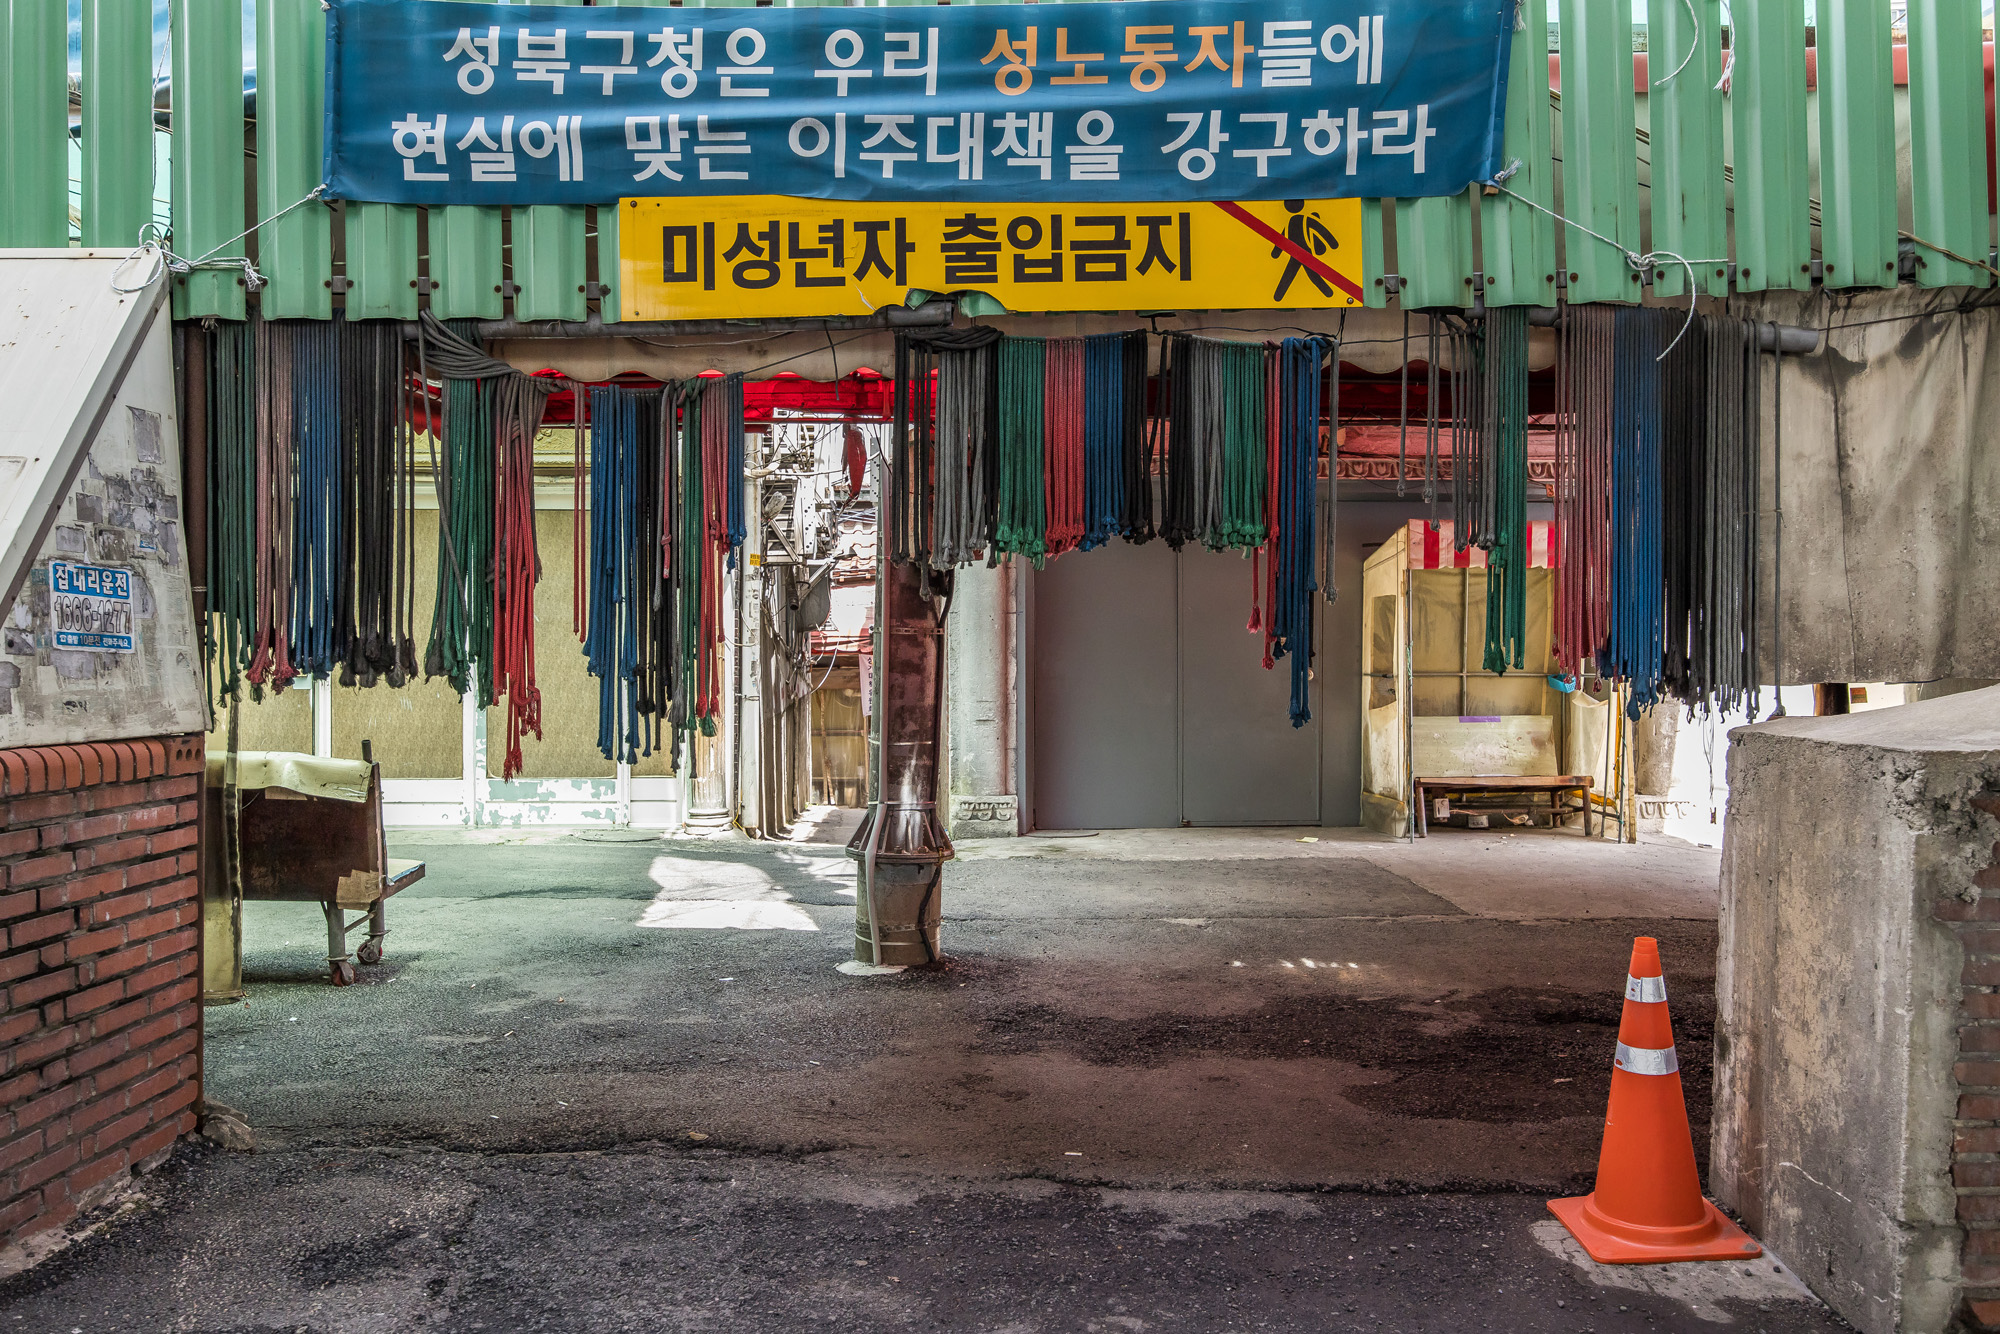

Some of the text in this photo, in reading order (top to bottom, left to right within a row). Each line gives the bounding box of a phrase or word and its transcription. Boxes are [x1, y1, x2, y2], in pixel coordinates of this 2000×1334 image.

[443, 15, 1384, 98] 성북구청은 우리 성노동자들에
[391, 104, 1436, 182] 현실에 맞는 이주대책을 강구하라
[662, 212, 1192, 291] 미성년자 출입금지
[54, 595, 132, 635] 1666-1277
